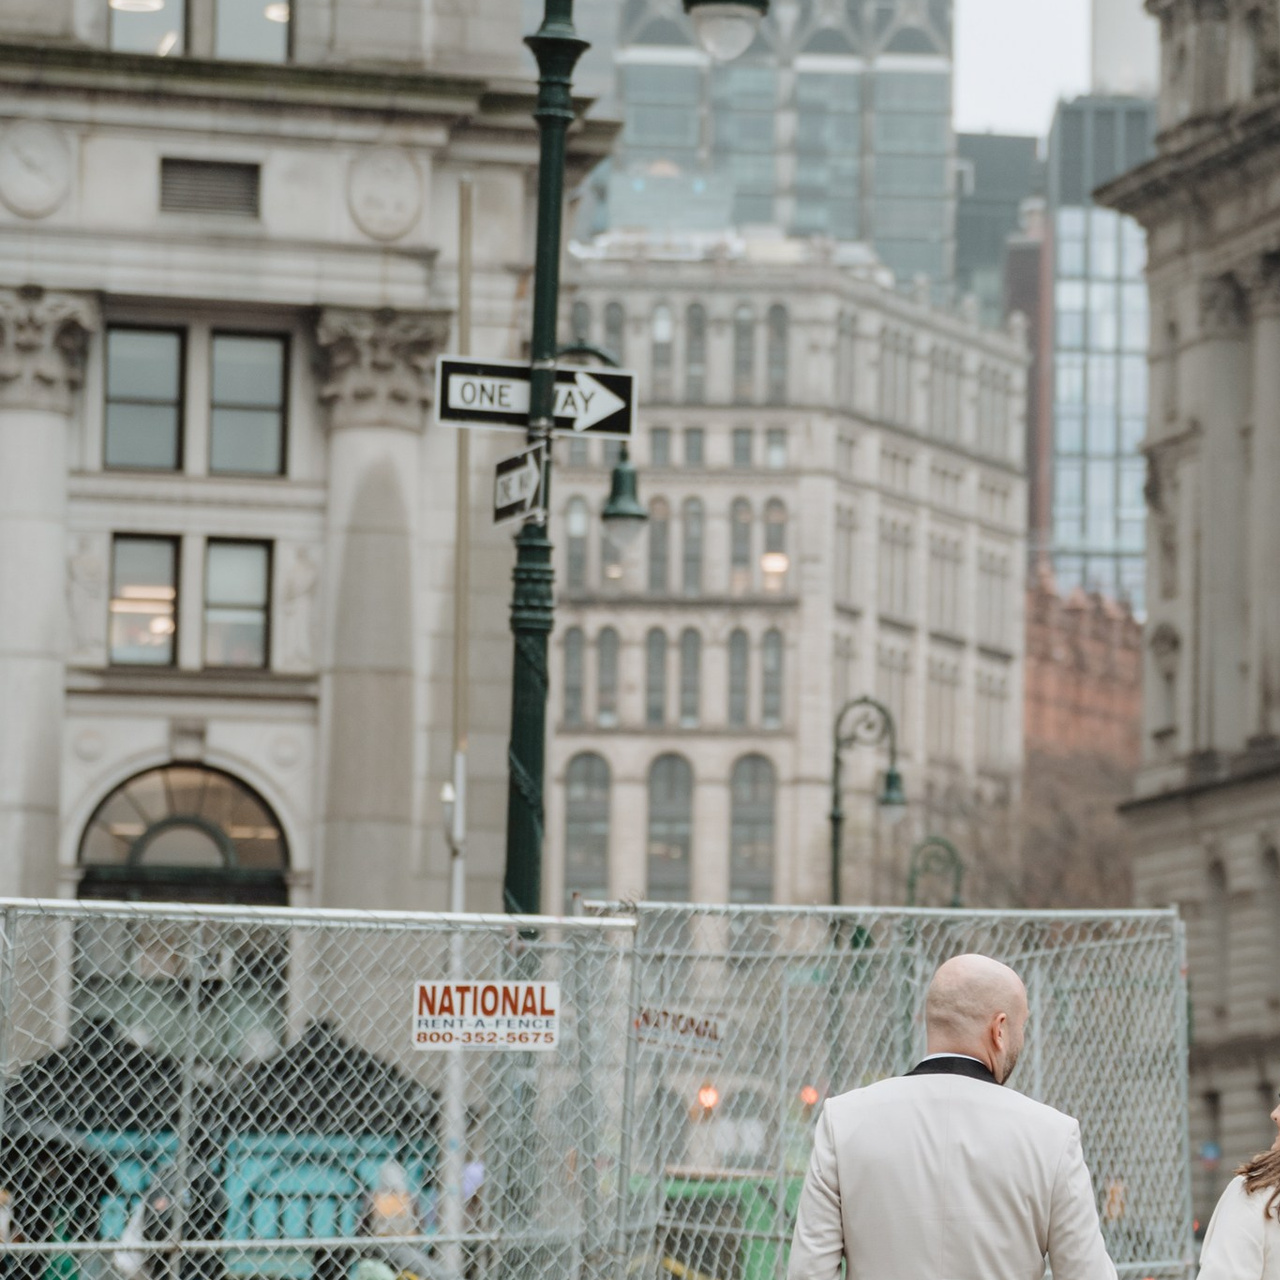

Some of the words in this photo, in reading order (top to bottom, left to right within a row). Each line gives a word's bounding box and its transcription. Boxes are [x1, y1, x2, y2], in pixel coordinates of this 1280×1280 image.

[460, 381, 512, 408] ONE
[554, 387, 596, 414] AY
[418, 985, 555, 1016] NATIONAL
[417, 1019, 555, 1029] RENT-A-FENCE
[416, 1031, 555, 1043] 800-352-5675
